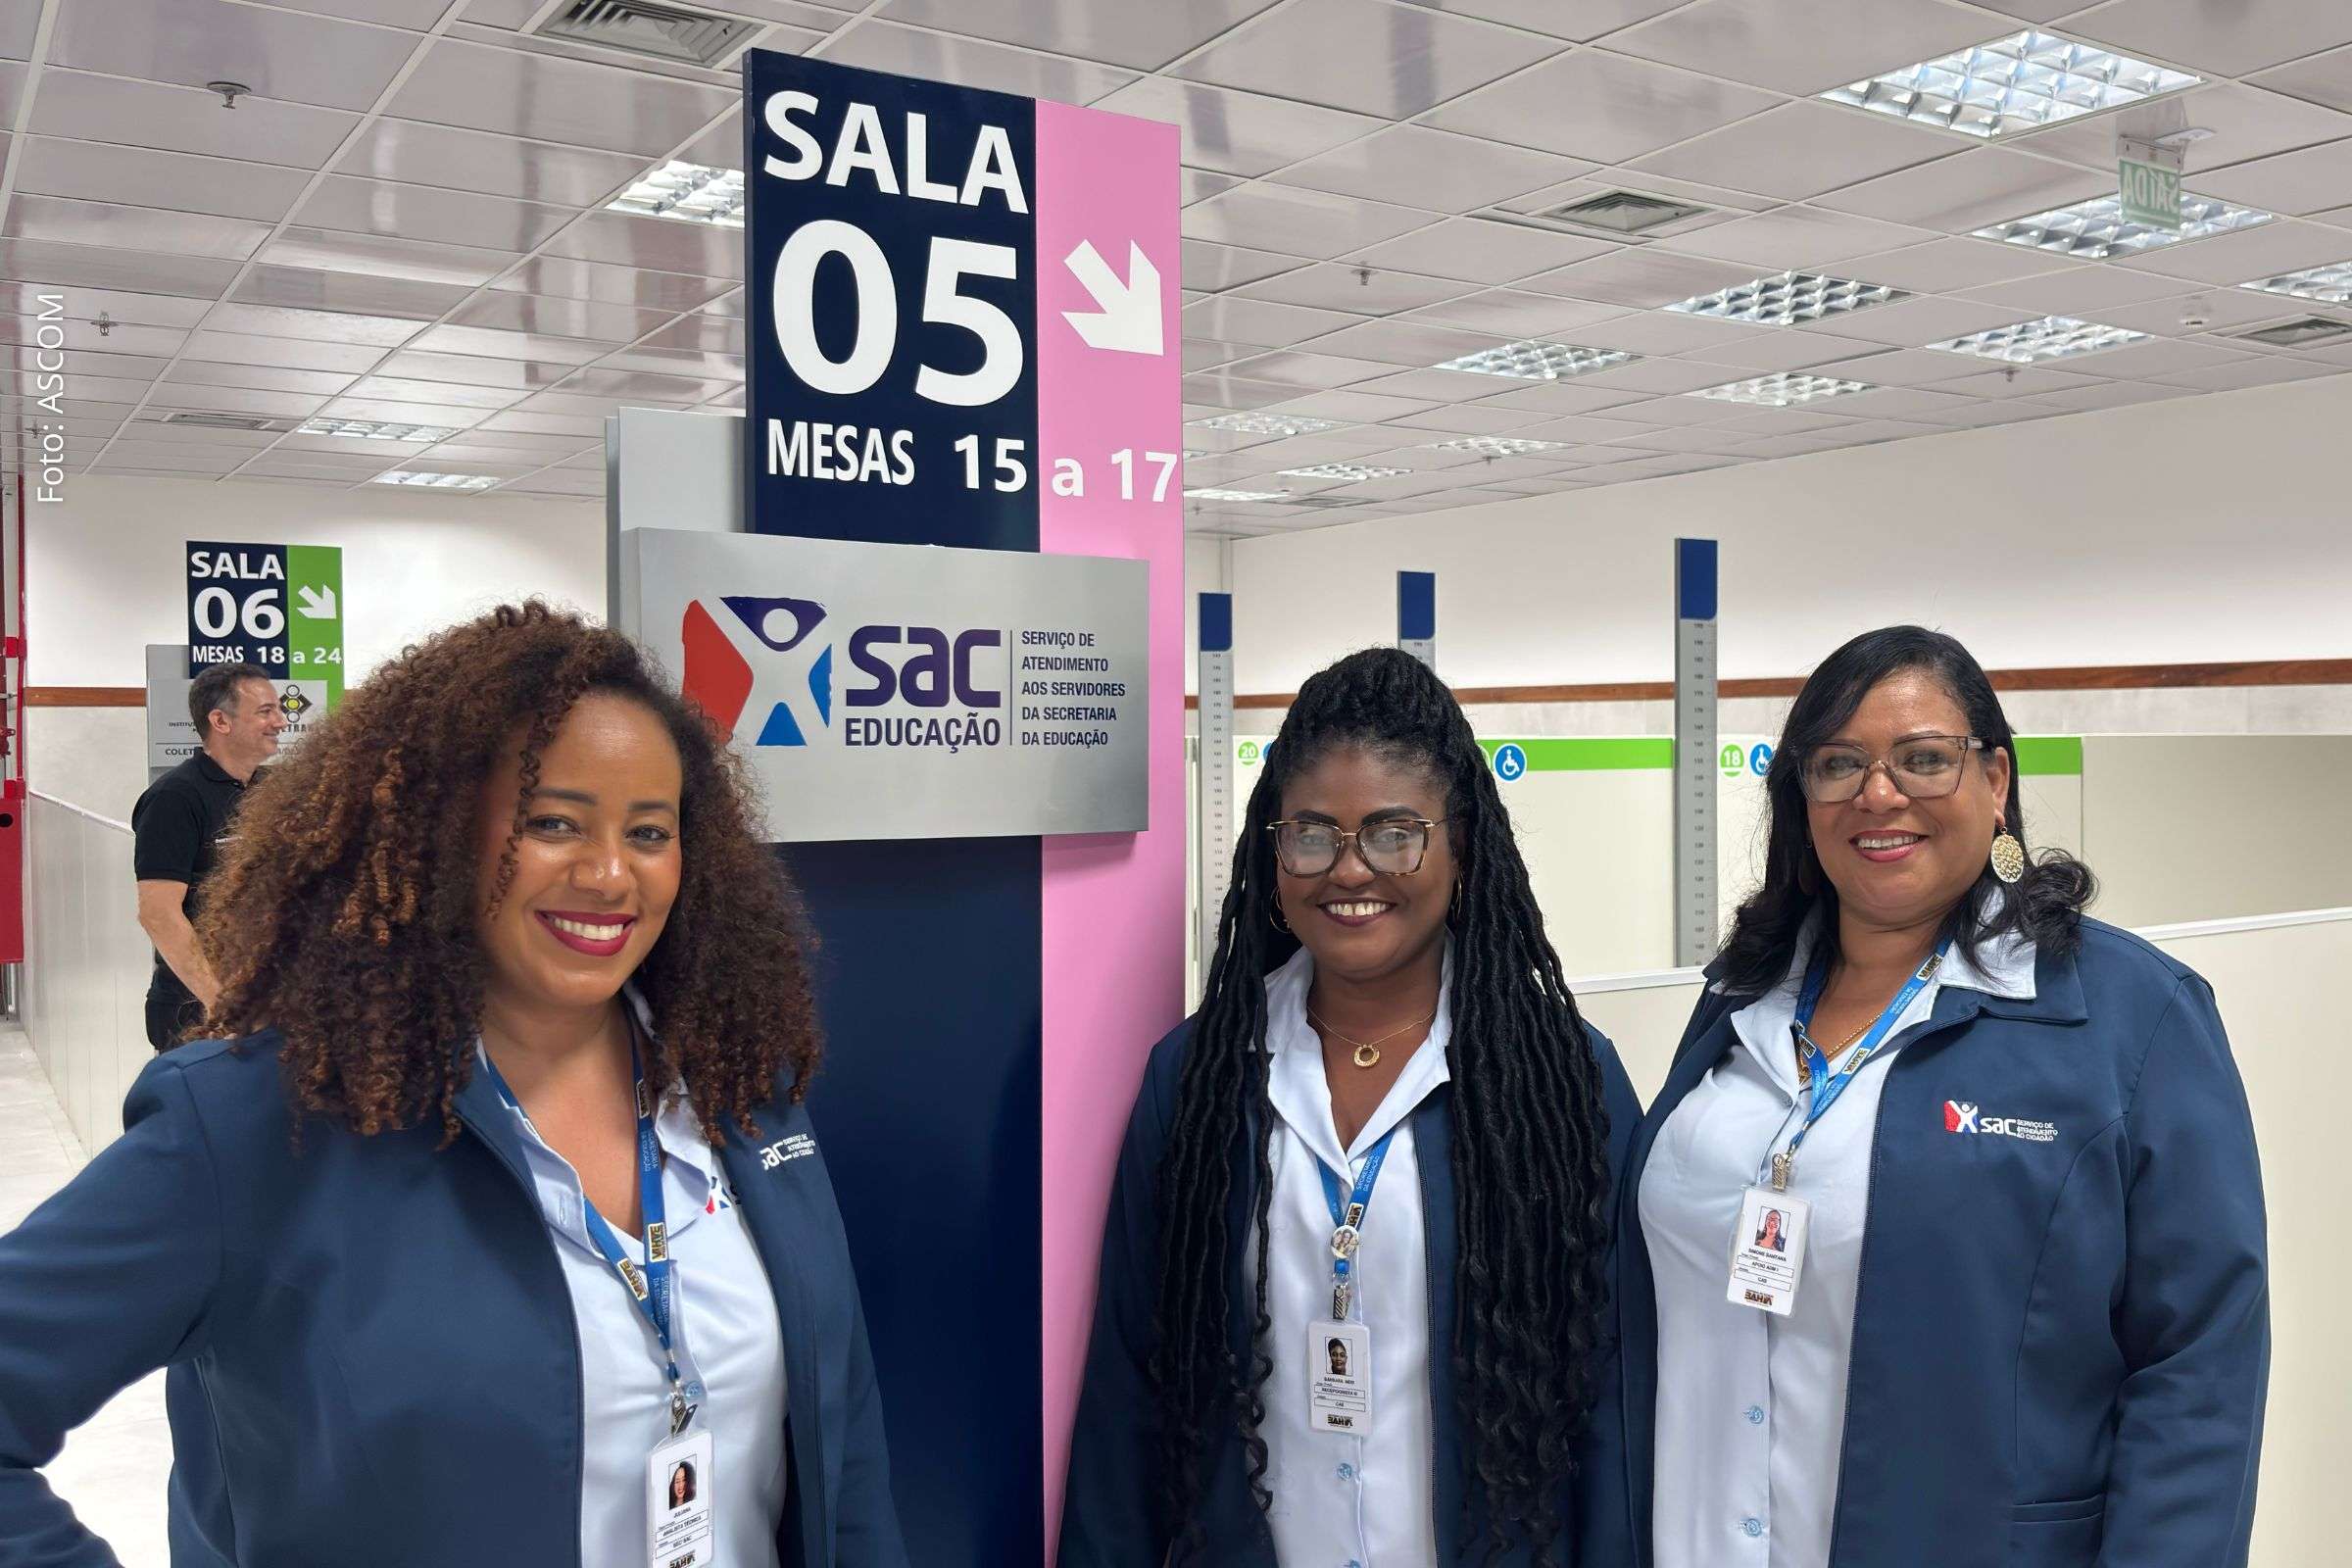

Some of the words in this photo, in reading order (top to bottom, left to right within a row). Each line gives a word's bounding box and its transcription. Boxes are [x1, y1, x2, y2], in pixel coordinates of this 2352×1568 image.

[763, 90, 1029, 215] SALA
[773, 220, 1023, 407] 05
[767, 418, 915, 486] MESAS
[955, 434, 1028, 492] 15
[1052, 458, 1085, 497] a
[1110, 448, 1178, 503] 17
[190, 551, 284, 581] SALA
[193, 587, 286, 641] 06
[1021, 630, 1075, 650] SERVIÇO
[1078, 632, 1096, 648] DE
[192, 645, 245, 664] MESAS
[257, 647, 285, 664] 18
[293, 650, 305, 663] a
[314, 647, 343, 664] 24
[1021, 656, 1108, 672] ATENDIMENTO
[1021, 682, 1048, 696] AOS
[1051, 682, 1126, 697] SERVIDORES
[1021, 707, 1041, 721] DA
[1043, 707, 1117, 721] SECRETARIA
[845, 712, 1001, 754] EDUCAÇÃO
[1021, 731, 1041, 746] DA
[1043, 728, 1108, 750] EDUCAÇÃO
[1240, 745, 1255, 759] 20
[1724, 750, 1741, 766] 18
[1980, 1117, 2017, 1137] sac
